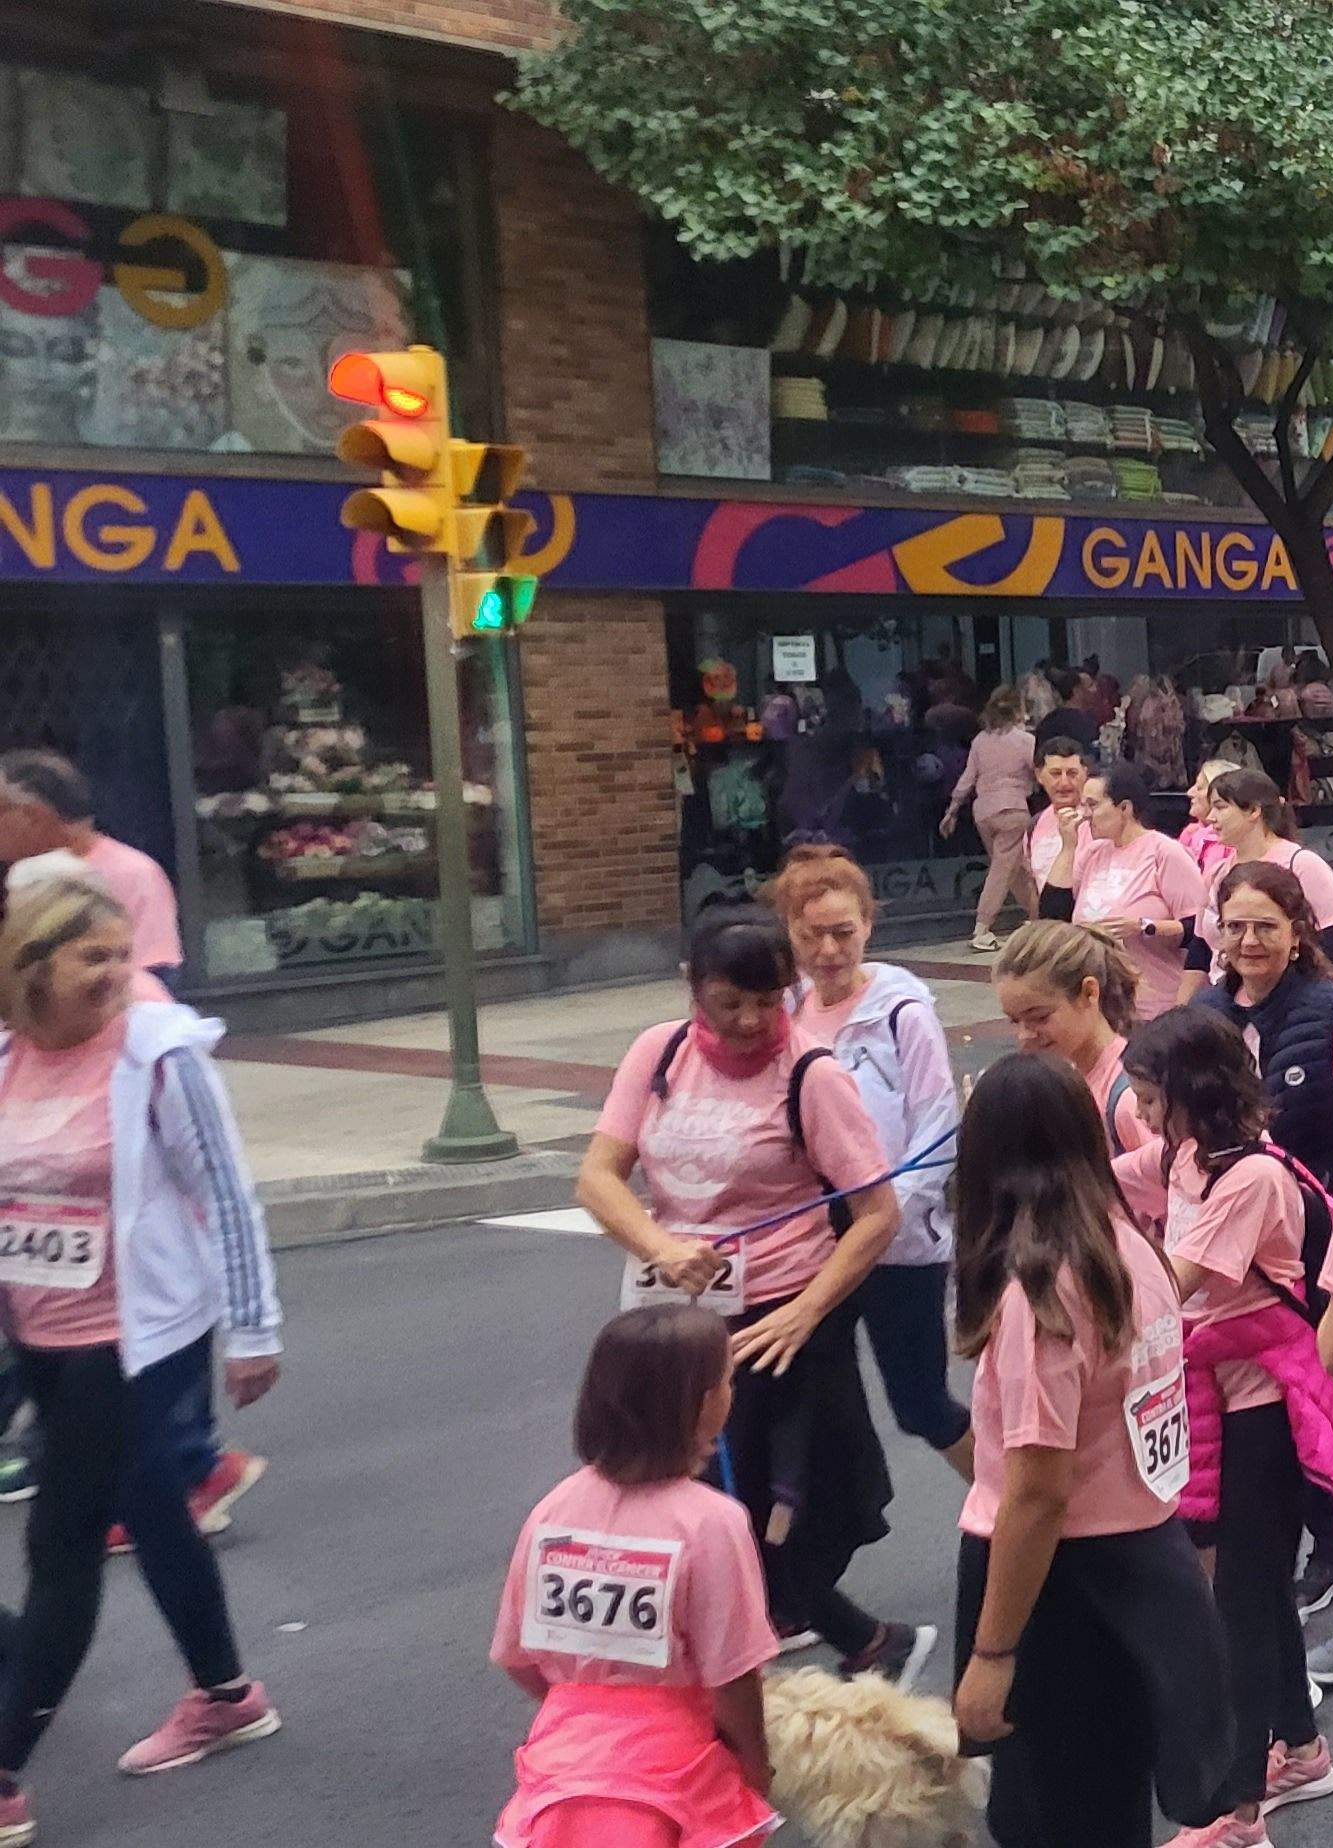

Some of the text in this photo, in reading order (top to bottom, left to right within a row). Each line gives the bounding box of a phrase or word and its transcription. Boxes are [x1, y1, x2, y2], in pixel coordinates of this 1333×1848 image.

[1081, 526, 1299, 592] GANGA
[0, 1224, 92, 1264] 2403
[540, 1572, 659, 1631] 3676
